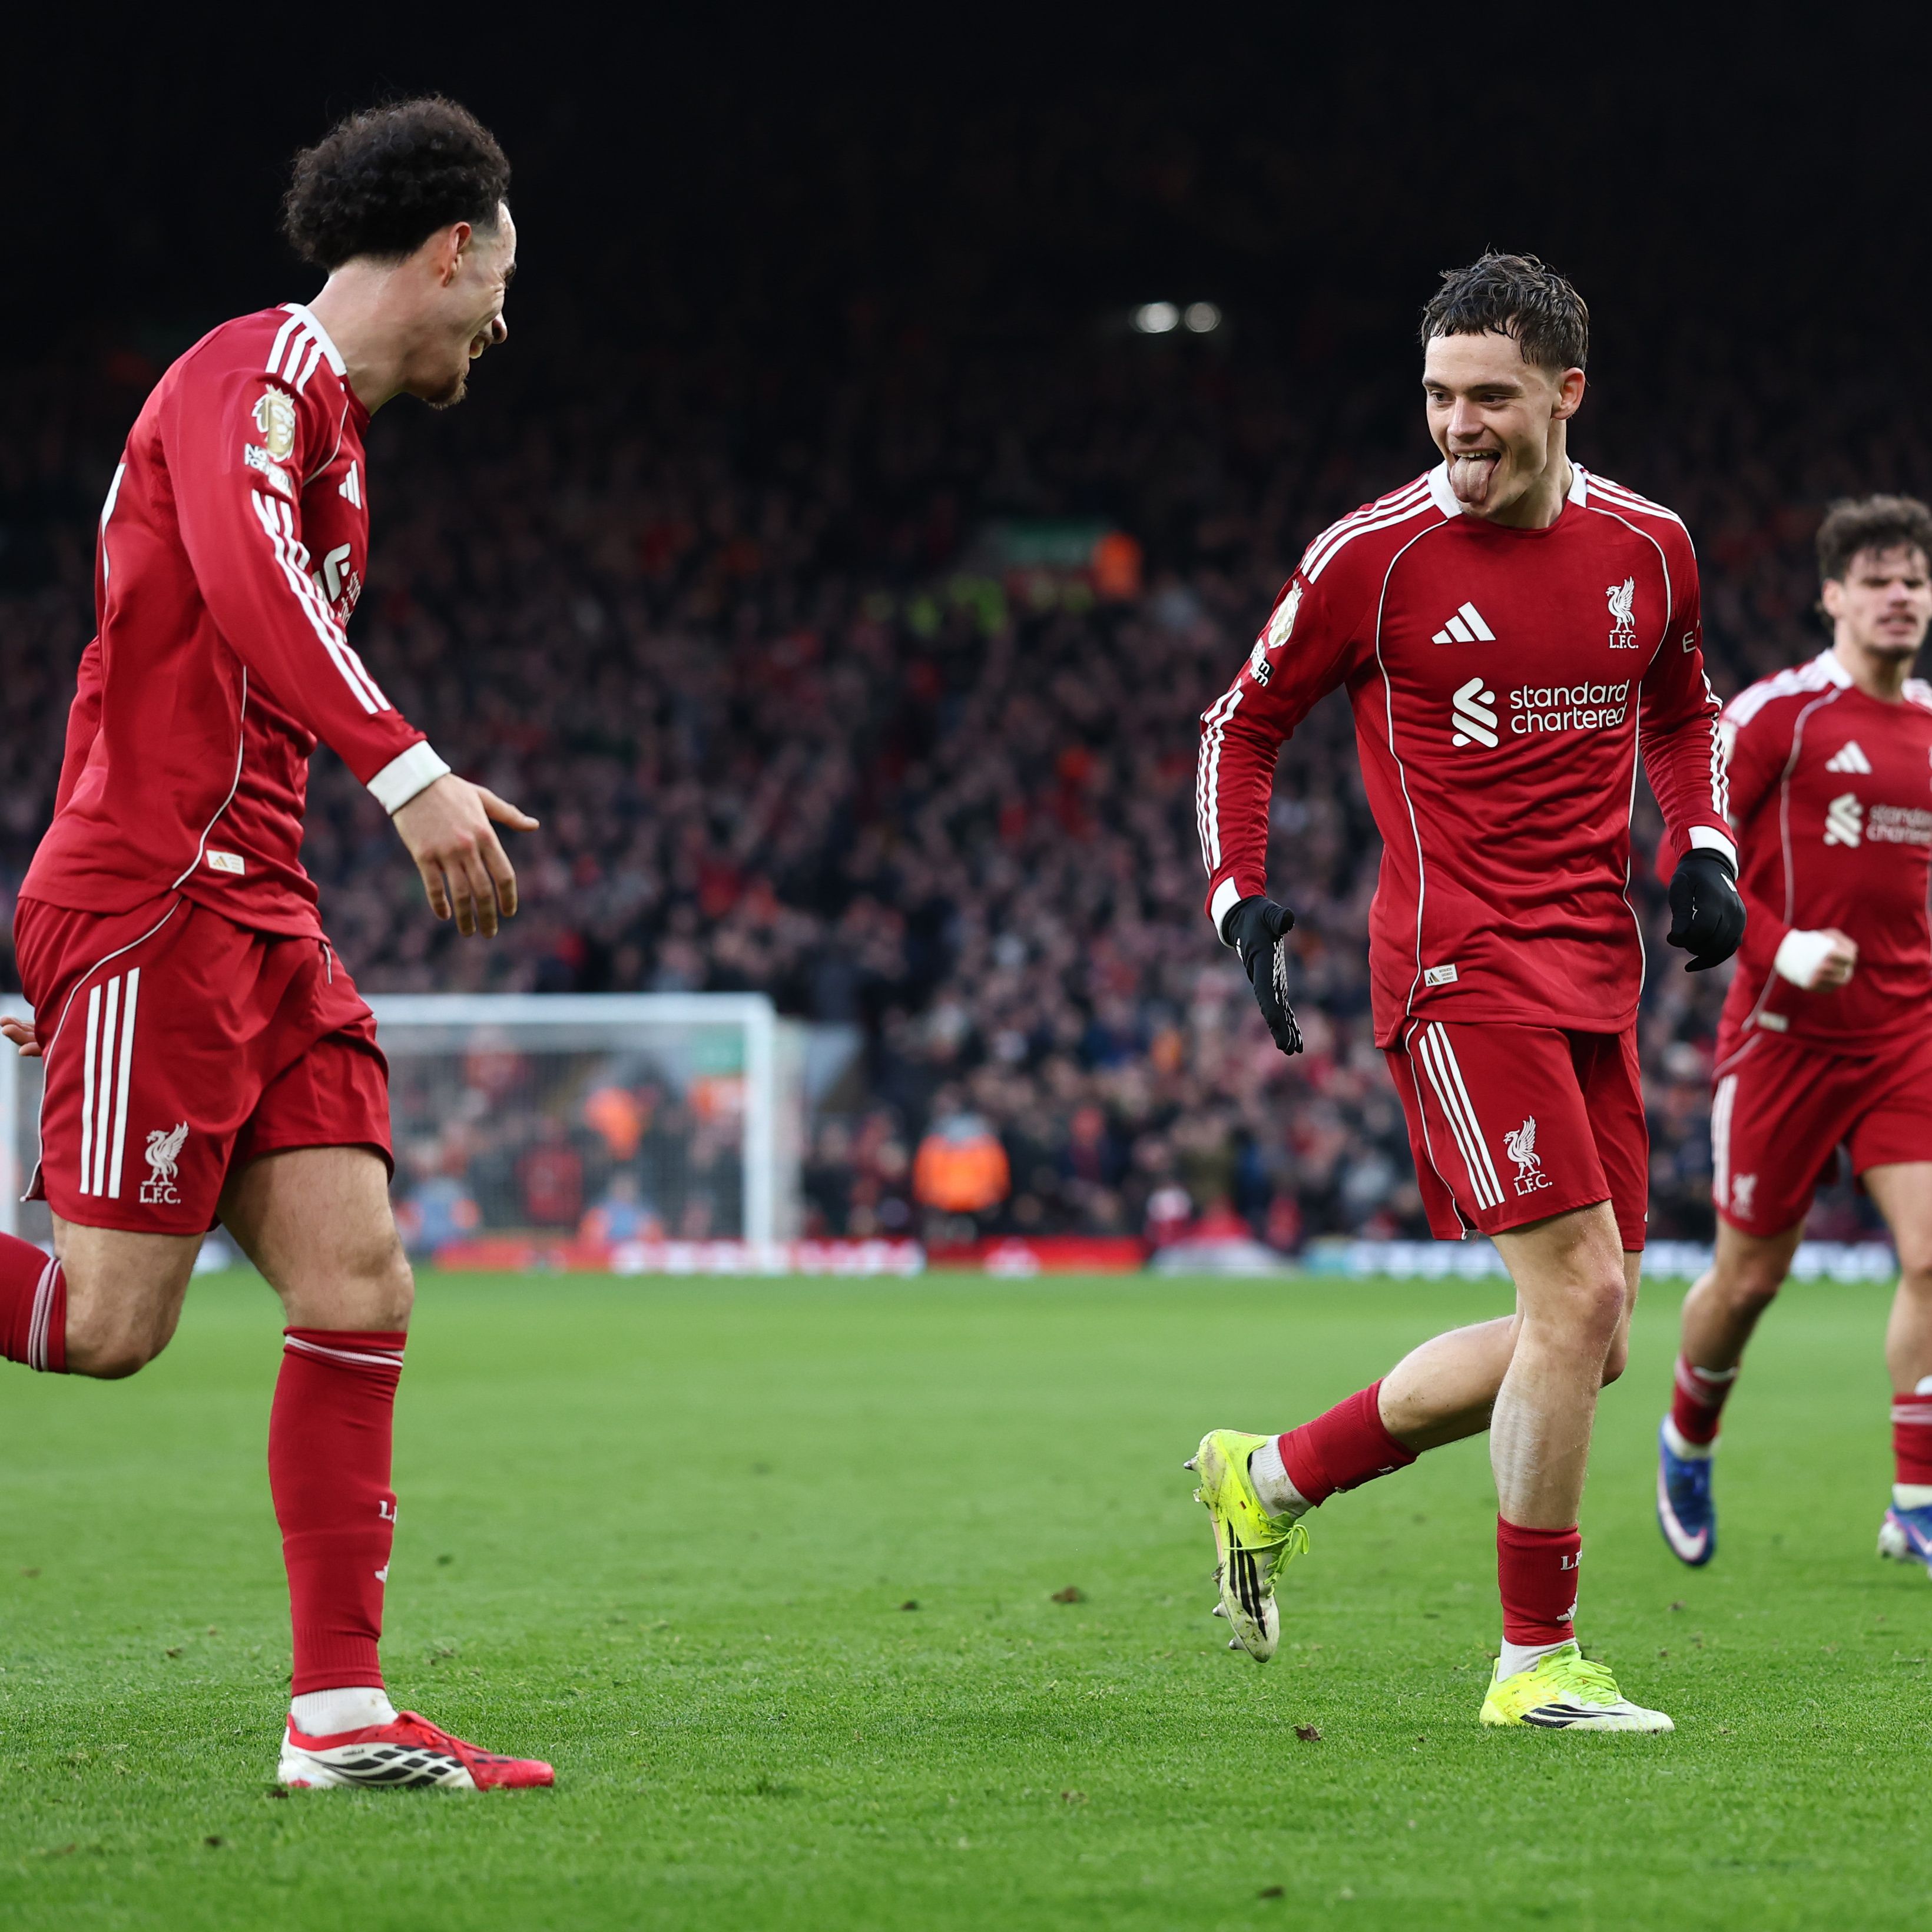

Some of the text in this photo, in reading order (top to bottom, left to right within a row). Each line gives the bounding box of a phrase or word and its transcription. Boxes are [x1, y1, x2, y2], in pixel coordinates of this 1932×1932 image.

[1609, 634, 1639, 648] L.F.C.
[1510, 679, 1630, 710] standard
[1511, 701, 1628, 734] chartered
[140, 1186, 181, 1204] L.F.C.
[1514, 1174, 1553, 1196] L.F.C.
